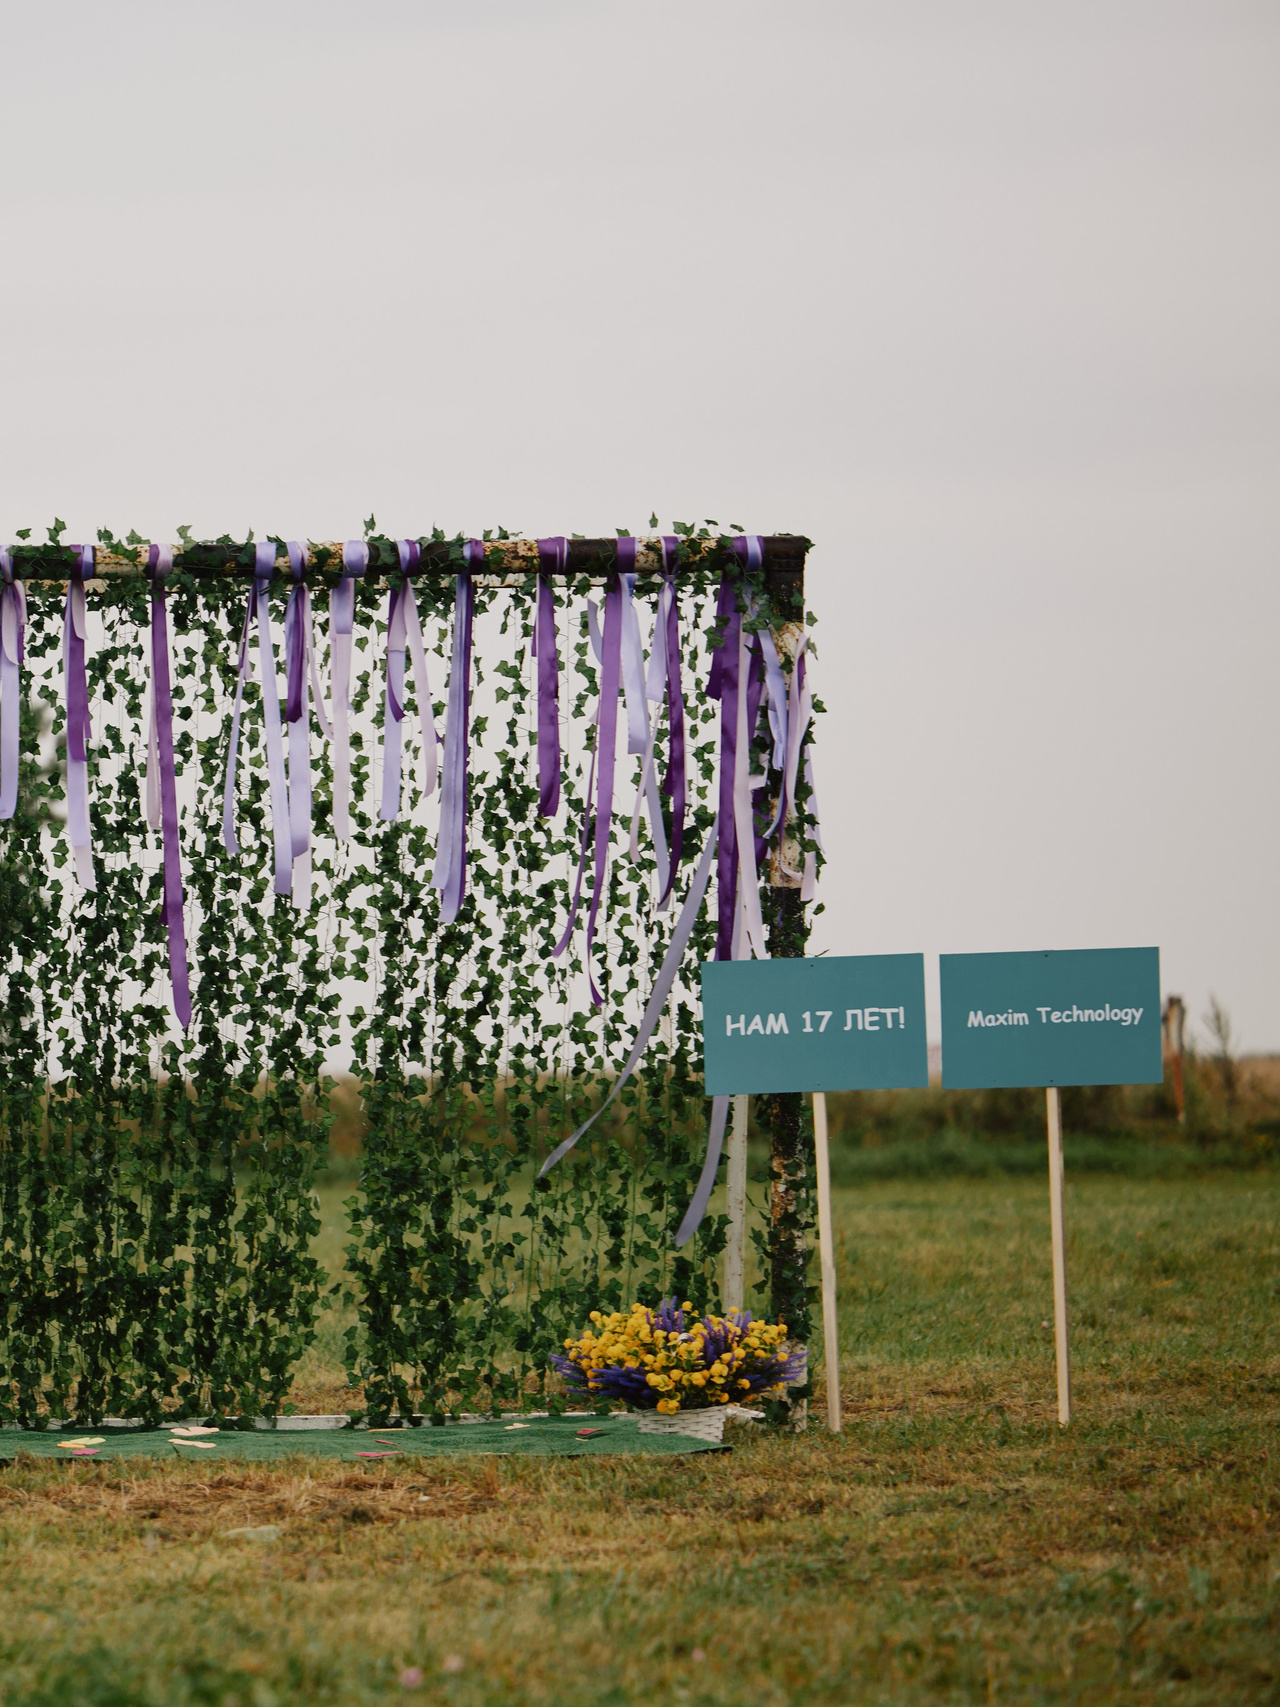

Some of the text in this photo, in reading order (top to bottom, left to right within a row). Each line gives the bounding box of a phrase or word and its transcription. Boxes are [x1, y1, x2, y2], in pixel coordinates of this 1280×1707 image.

[726, 1006, 905, 1036] НАМ 17 ЛЕТ!
[967, 1003, 1144, 1028] Maxim Technology
